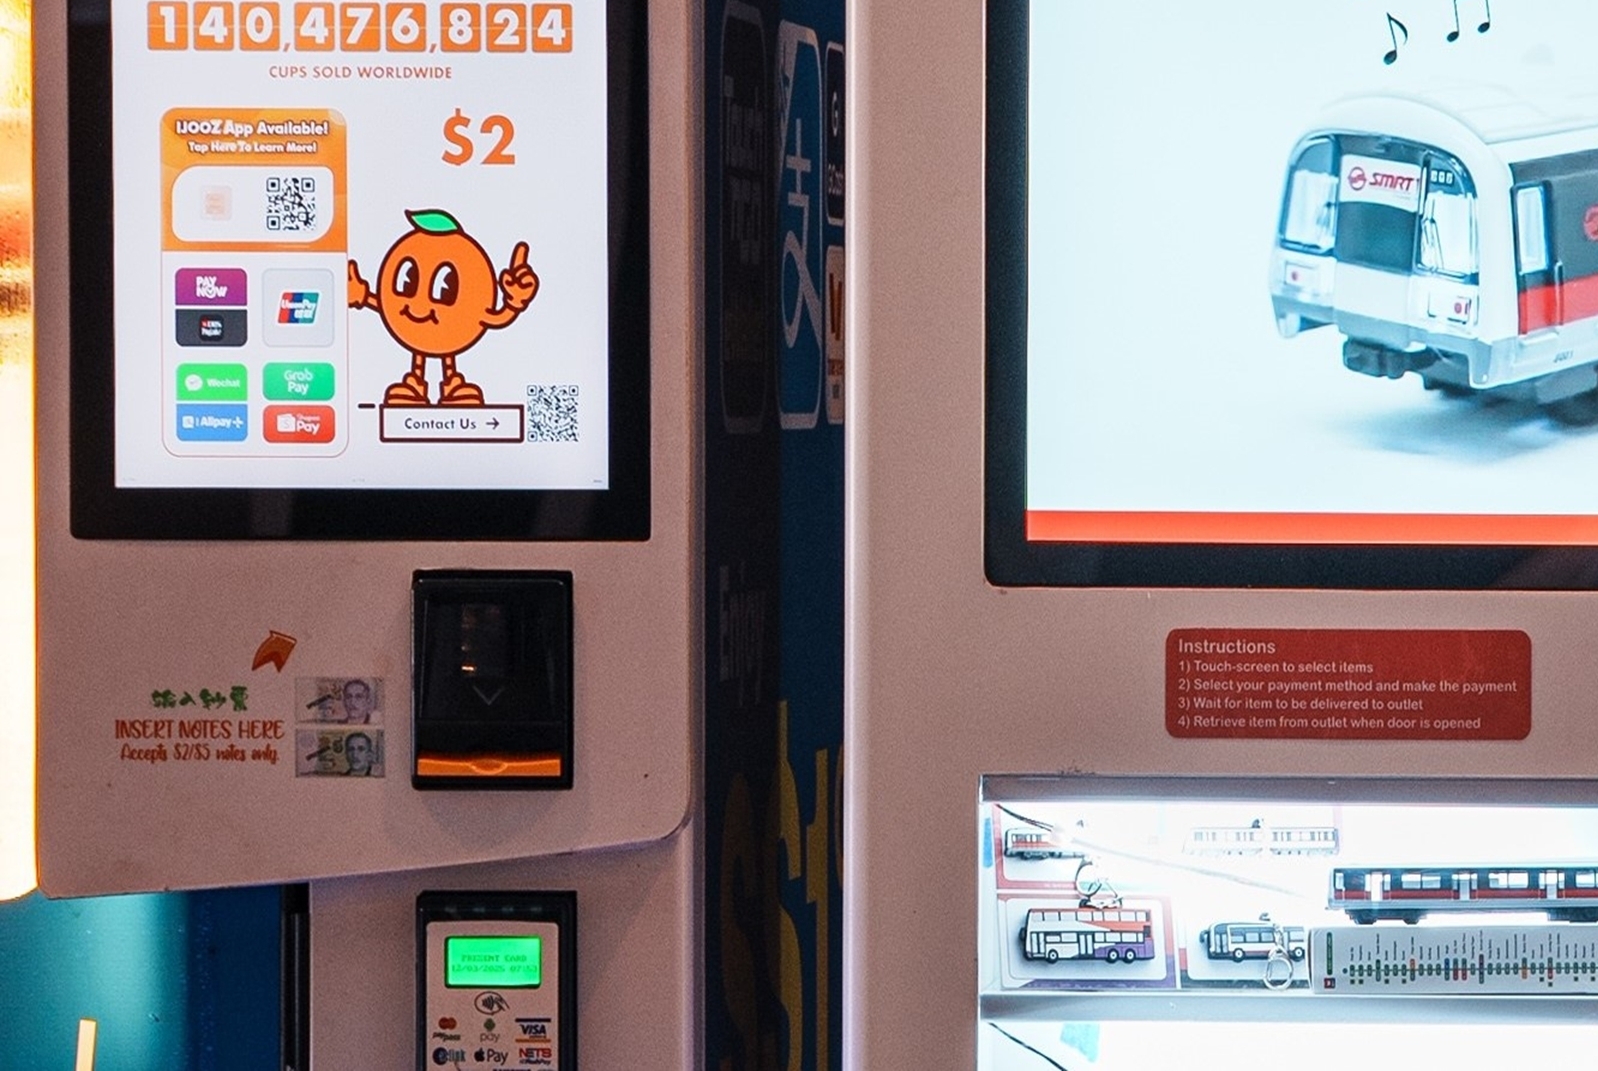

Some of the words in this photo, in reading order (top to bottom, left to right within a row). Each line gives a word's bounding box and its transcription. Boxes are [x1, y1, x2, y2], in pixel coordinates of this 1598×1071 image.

[268, 65, 308, 79] CUPS
[313, 65, 352, 79] SOLD
[357, 66, 453, 80] WORLDWIDE
[223, 120, 254, 137] App
[257, 121, 329, 136] Available!
[441, 108, 516, 167] $2
[188, 141, 208, 154] Tap
[253, 141, 284, 153] Learn
[285, 142, 318, 153] More!
[1368, 172, 1414, 192] SMRT
[196, 276, 217, 287] PAY
[283, 369, 314, 382] Grab
[287, 381, 309, 395] Pay
[296, 420, 320, 435] Pay
[404, 417, 455, 430] Contact
[460, 417, 477, 430] Us
[1178, 638, 1276, 655] Instructions
[1178, 660, 1191, 674] 1)
[1194, 660, 1279, 673] Touch-screen
[1282, 661, 1295, 673] to
[1298, 661, 1336, 673] select
[1339, 661, 1373, 673] items
[1178, 678, 1191, 692] 2)
[1193, 678, 1233, 692] Select
[1236, 681, 1265, 694] your
[1268, 681, 1322, 695] payment
[1325, 679, 1372, 692] method
[1375, 679, 1399, 692] and
[1402, 679, 1436, 692] make
[1439, 680, 1459, 692] the
[1462, 681, 1517, 695] payment
[1178, 696, 1191, 711] 3)
[1193, 697, 1221, 710] Wait
[1224, 697, 1242, 709] for
[1245, 697, 1272, 709] item
[1275, 698, 1288, 709] to
[1291, 697, 1307, 710] be
[1310, 697, 1369, 710] delivered
[1371, 698, 1384, 710] to
[1387, 698, 1423, 710] outlet
[115, 719, 174, 740] INSERT
[178, 720, 233, 740] NOTES
[238, 719, 286, 740] HERE
[1178, 715, 1191, 729] 4)
[1193, 715, 1246, 728] Retrieve
[1249, 715, 1276, 728] item
[1279, 716, 1308, 728] from
[1311, 716, 1347, 728] outlet
[1350, 716, 1384, 728] when
[1388, 716, 1417, 729] door
[1420, 716, 1430, 729] is
[1433, 716, 1481, 730] opened
[120, 742, 168, 764] Accepts
[216, 744, 246, 761] notes
[520, 1024, 546, 1035] VISA
[487, 1049, 508, 1065] Pay
